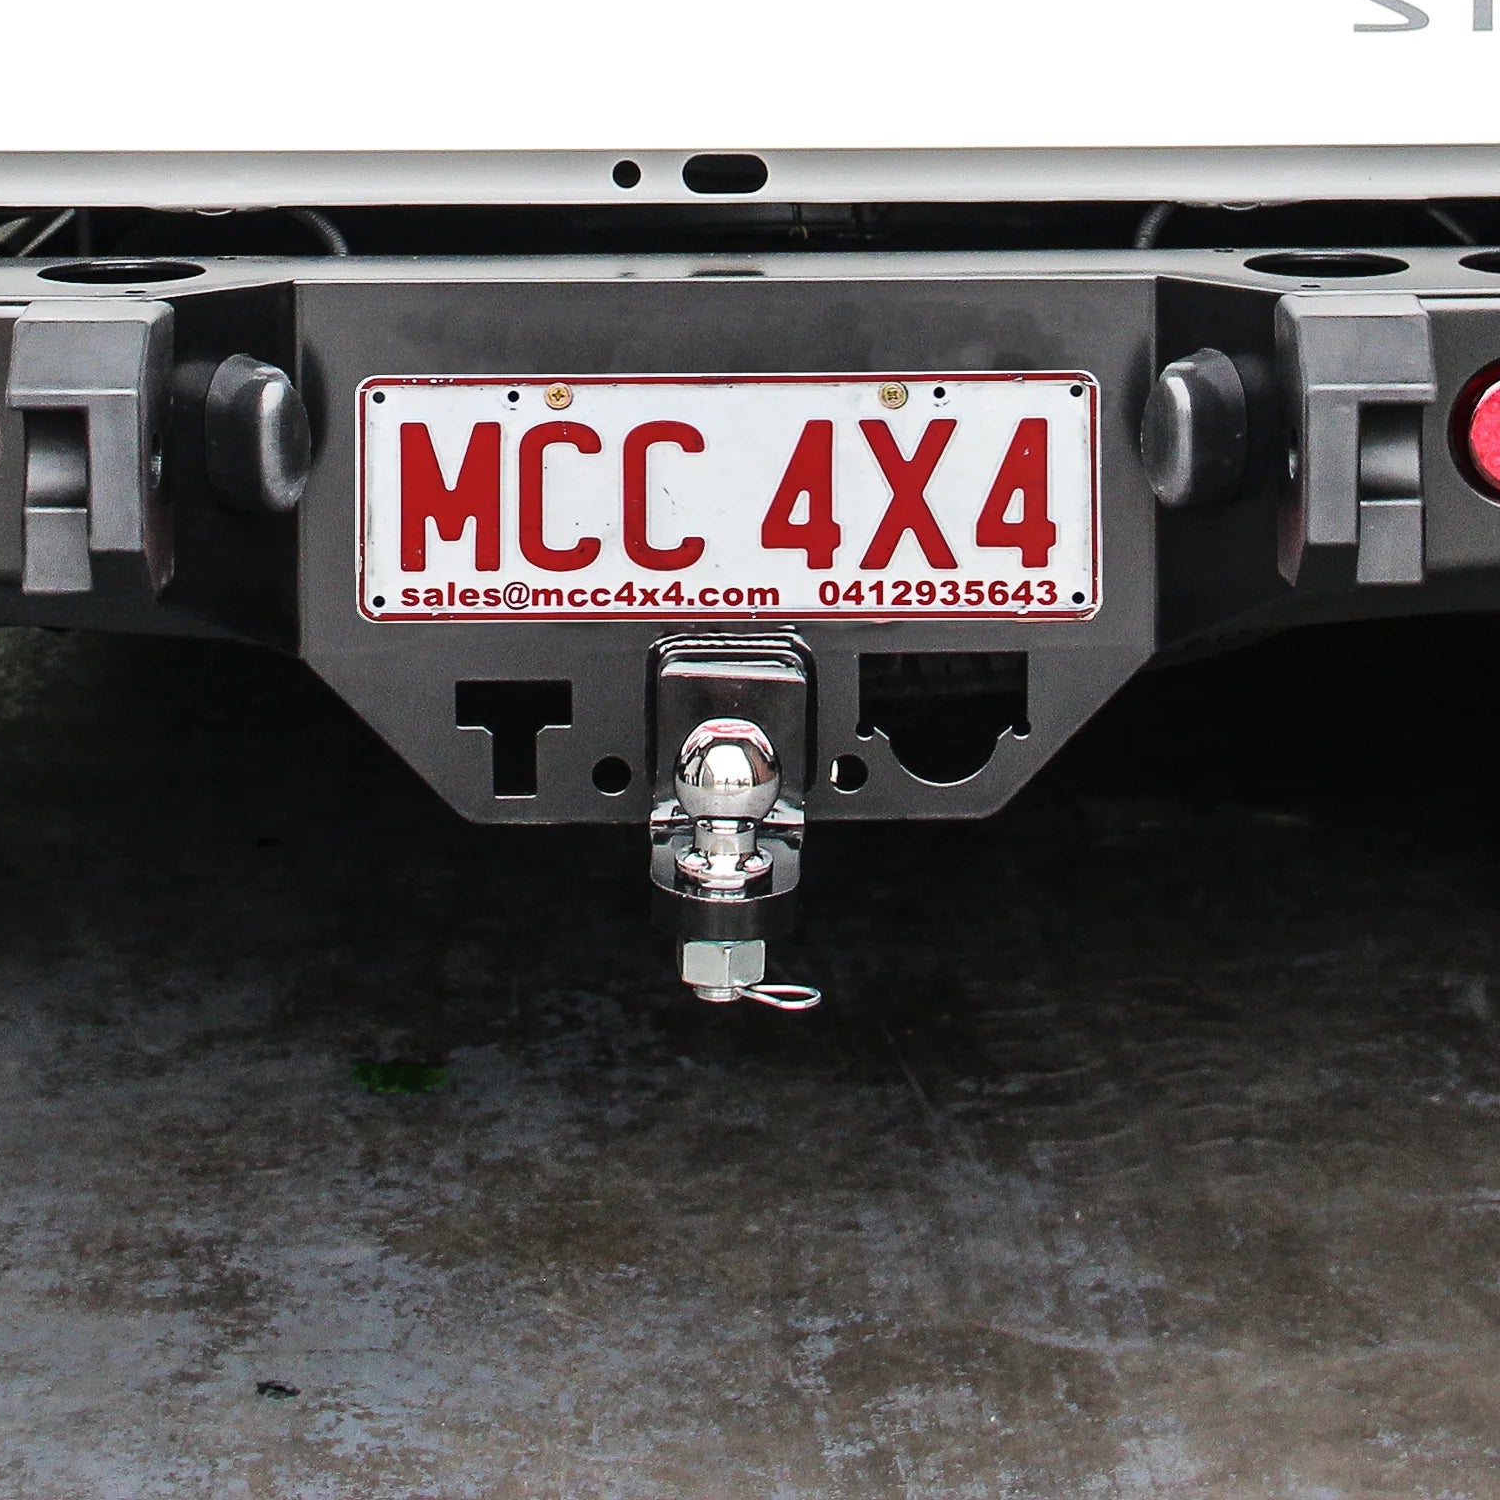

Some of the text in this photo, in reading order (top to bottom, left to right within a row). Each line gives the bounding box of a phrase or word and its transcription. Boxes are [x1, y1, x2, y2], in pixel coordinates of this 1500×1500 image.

[399, 417, 1057, 573] MCC 4X4
[401, 579, 1058, 609] sales@mcc4x4.com 0412935643
